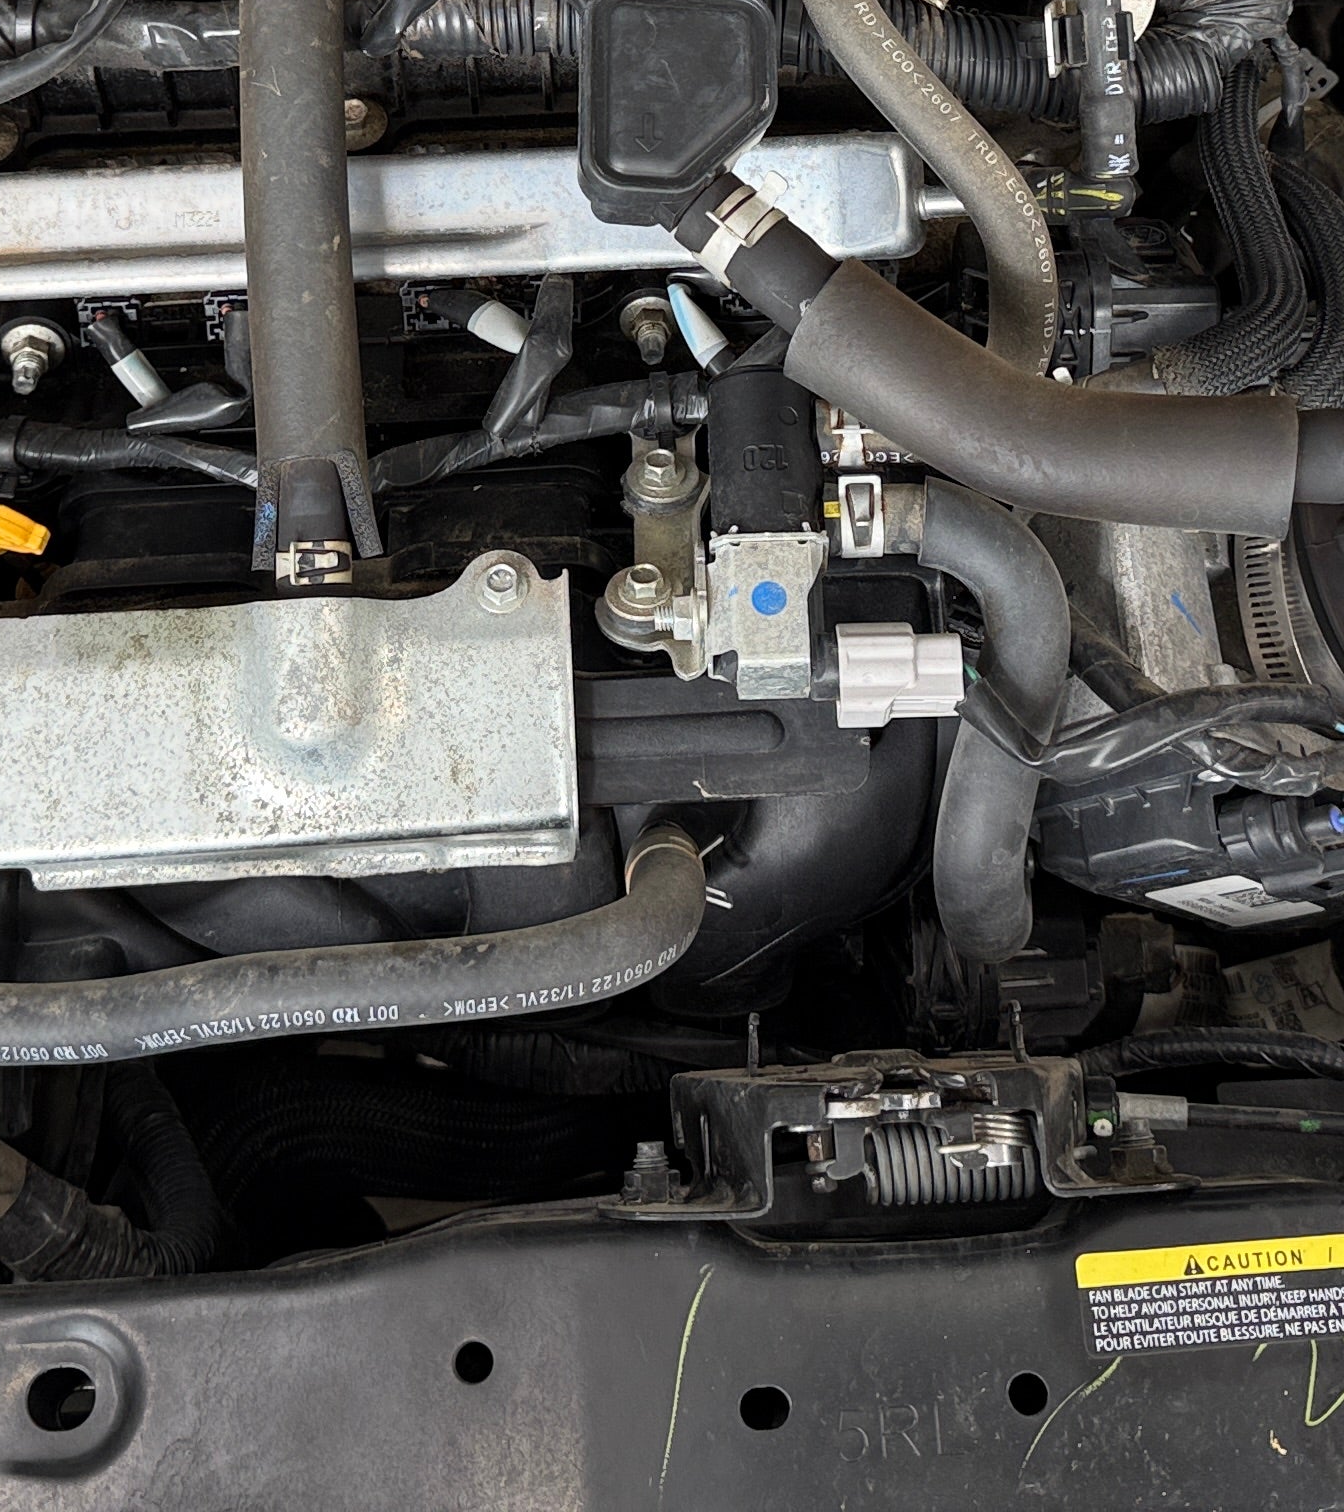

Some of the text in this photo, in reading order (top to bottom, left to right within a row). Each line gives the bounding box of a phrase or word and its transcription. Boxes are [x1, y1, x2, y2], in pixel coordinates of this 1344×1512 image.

[1103, 59, 1125, 98] DTR
[590, 958, 654, 995] 050122
[257, 1007, 327, 1031] 050122
[366, 1004, 400, 1023] DOT
[442, 995, 511, 1018] >EPDM<
[82, 1042, 110, 1061] DOT
[1207, 1248, 1304, 1273] CAUTION
[1088, 1274, 1285, 1306] FAN BLADE CAN START AT ANY TIME.
[1091, 1304, 1110, 1321] TO
[1109, 1301, 1139, 1319] HELP
[1140, 1299, 1178, 1317] AVOID
[1178, 1294, 1237, 1314] PERSONAL
[1237, 1290, 1281, 1310] INJURY,
[1280, 1288, 1308, 1305] KEEP
[1092, 1320, 1108, 1337] LE
[1107, 1313, 1193, 1336] VENTILATEUR
[1193, 1309, 1241, 1330] RISQUE
[1241, 1307, 1259, 1324] DE
[1259, 1303, 1327, 1323] DÉMARRER
[1328, 1300, 1340, 1317] À
[1095, 1335, 1133, 1354] POUR
[1133, 1331, 1175, 1351] ÉVITER
[1175, 1329, 1220, 1349] TOUTE
[1219, 1324, 1285, 1346] BLESSURE,
[1284, 1321, 1304, 1338] NE
[1305, 1320, 1328, 1336] PAS
